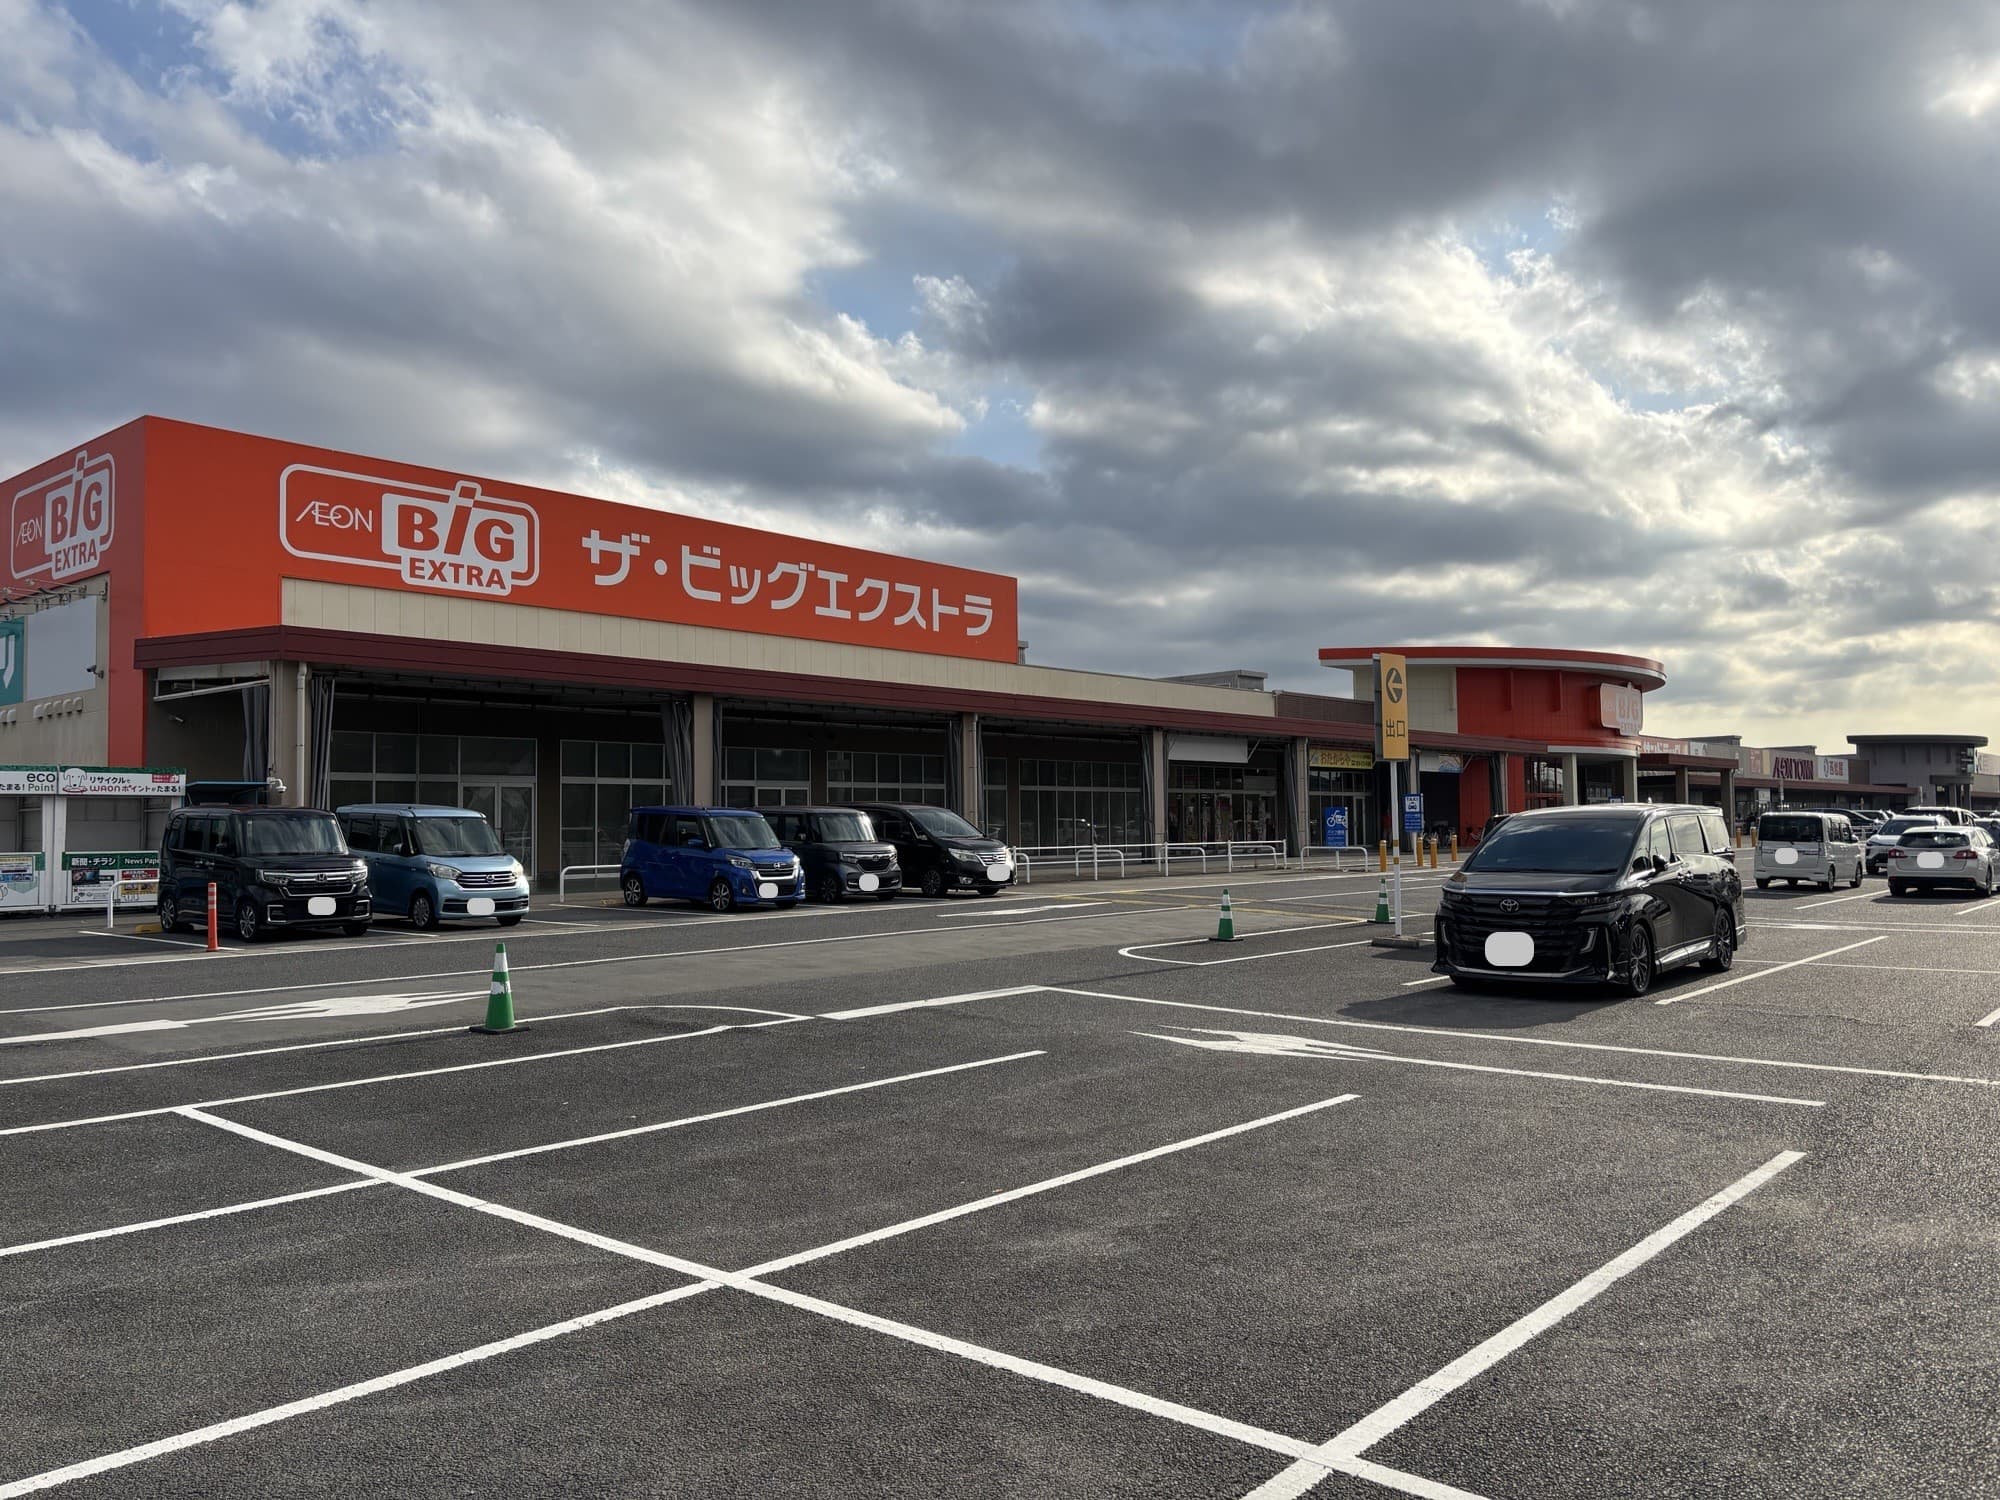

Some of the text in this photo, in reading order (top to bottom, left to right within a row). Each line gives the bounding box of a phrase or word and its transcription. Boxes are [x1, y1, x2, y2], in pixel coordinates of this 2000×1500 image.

[54, 538, 98, 573] EXTRA
[408, 556, 508, 590] EXTRA
[581, 528, 994, 637] ザ・ビッグエクストラ
[1385, 718, 1406, 738] 出口
[26, 773, 56, 783] eco
[28, 783, 55, 792] Point
[71, 857, 116, 866] 新聞・チラシ
